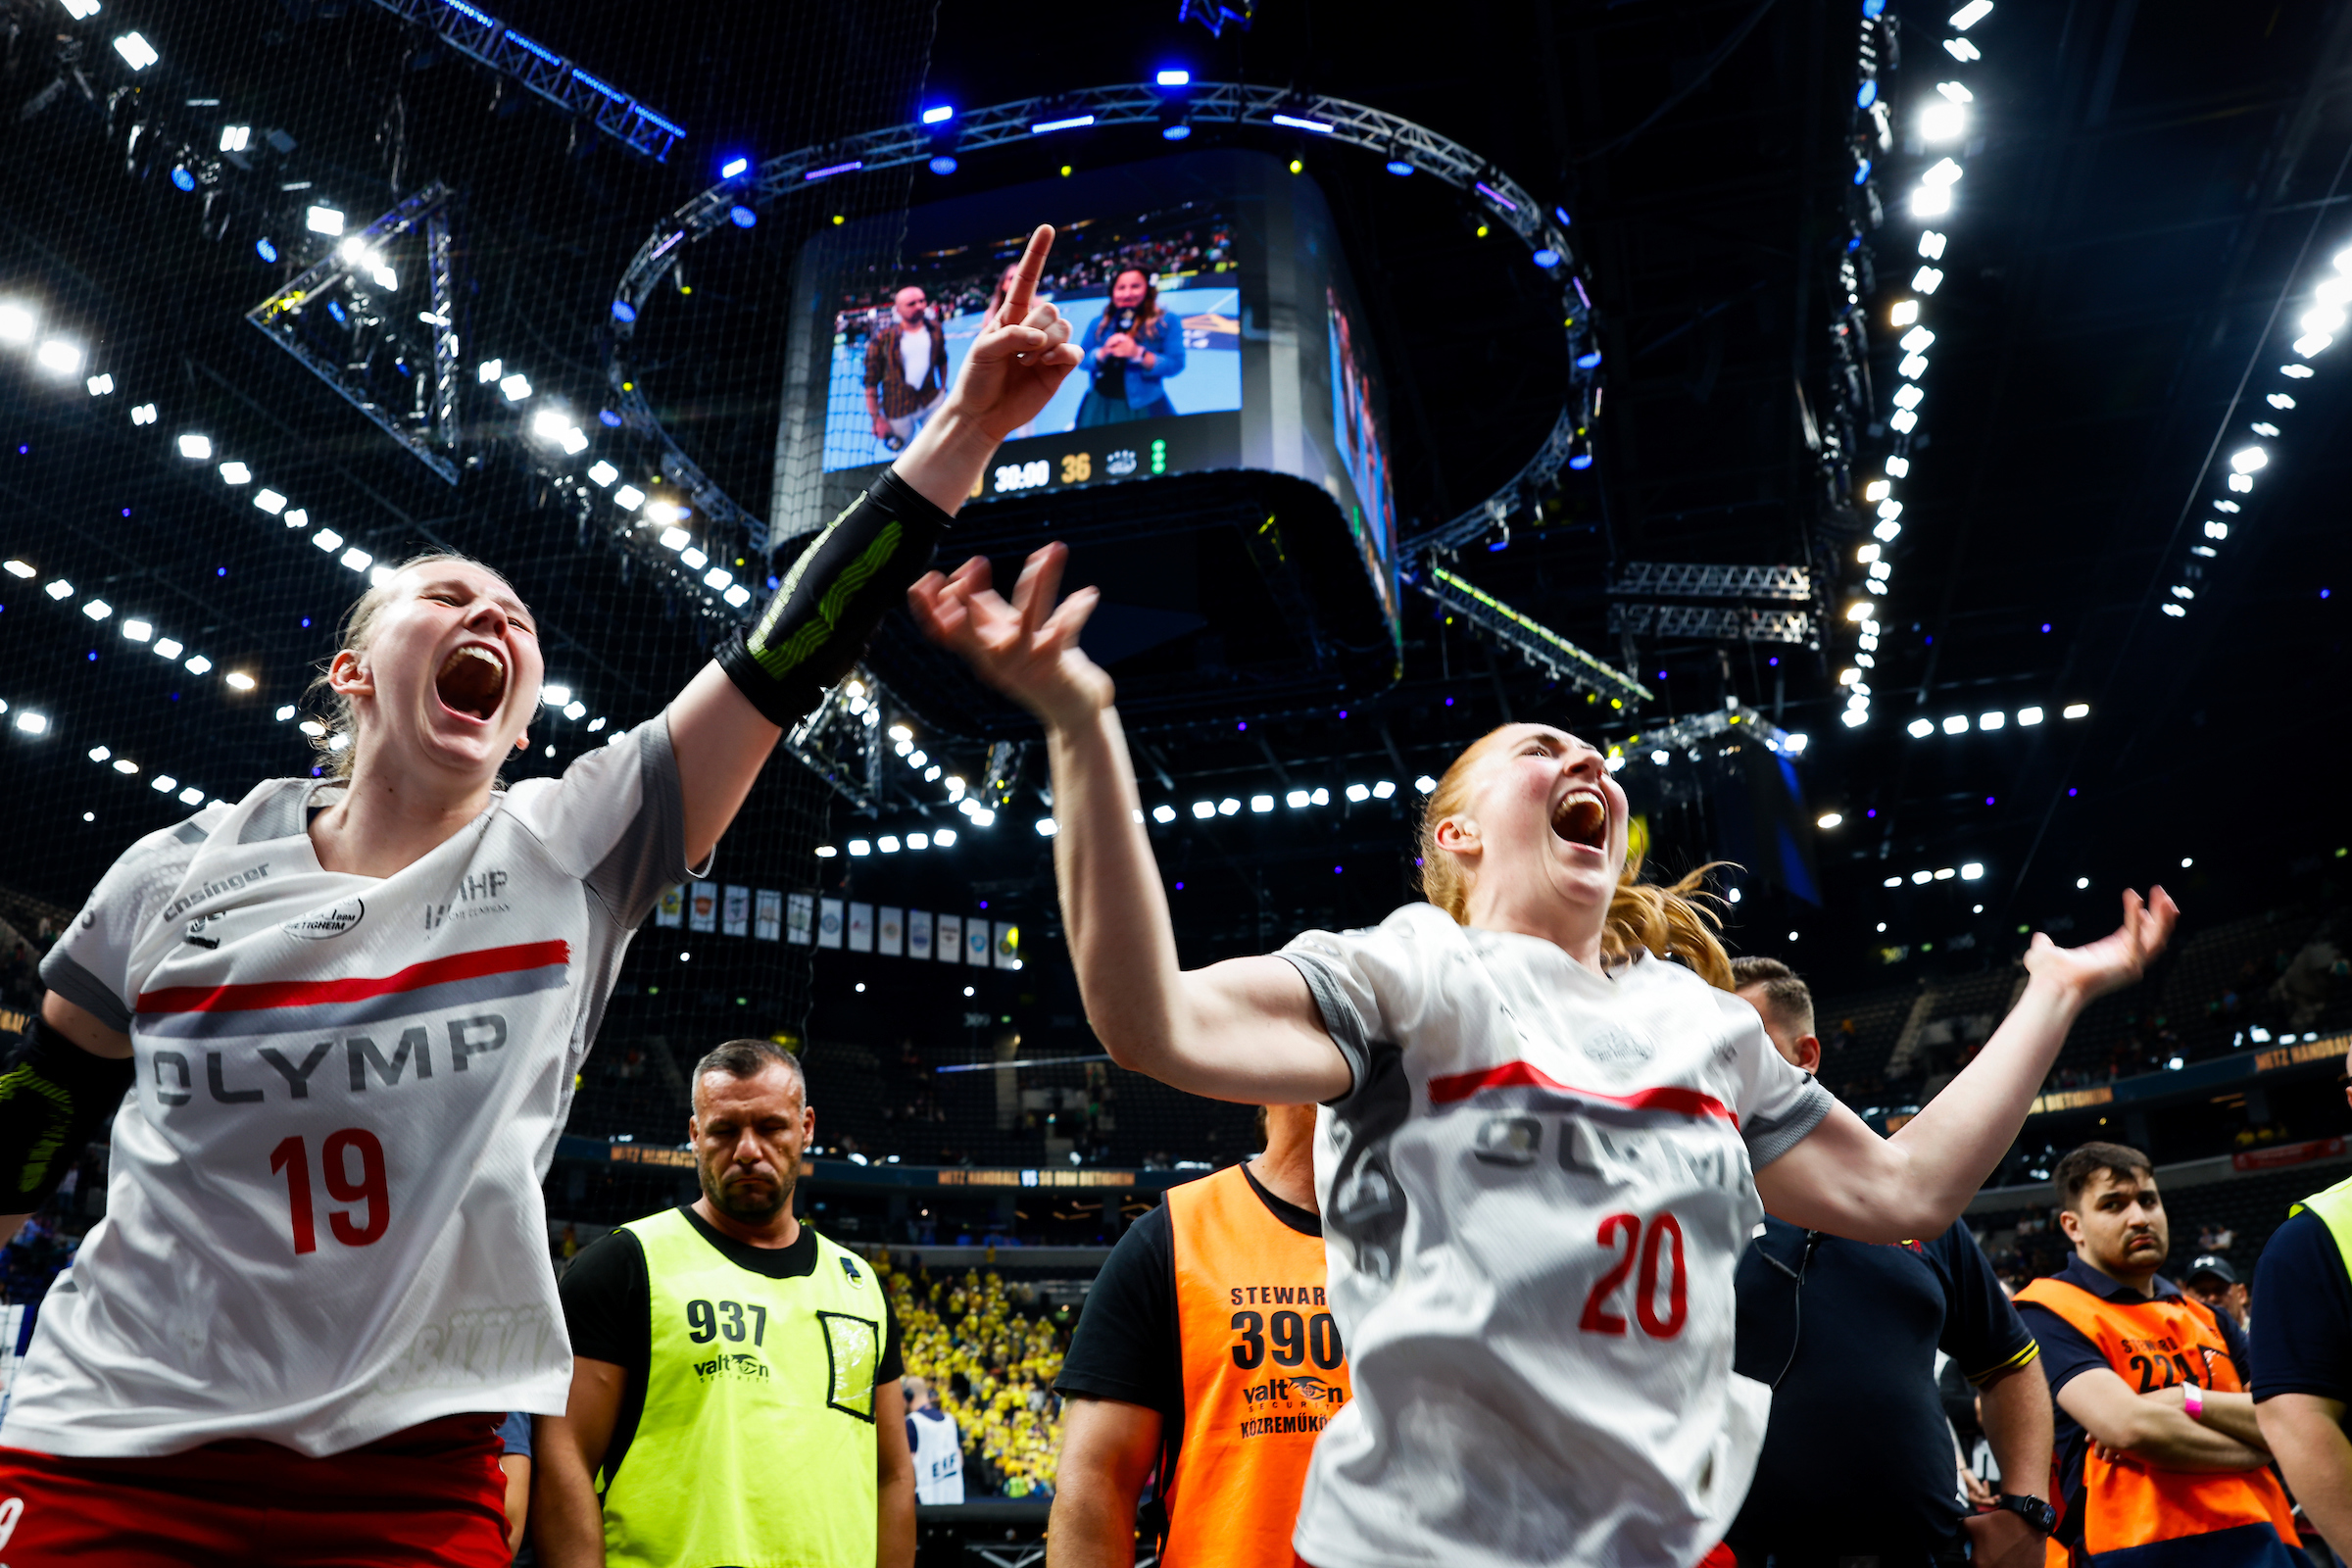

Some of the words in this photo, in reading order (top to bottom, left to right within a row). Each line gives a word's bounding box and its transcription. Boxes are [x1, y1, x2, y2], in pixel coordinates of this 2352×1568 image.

[994, 460, 1051, 493] 30:00
[1060, 453, 1092, 484] 36
[164, 863, 270, 922] ensinger
[153, 1013, 509, 1107] OLYMP
[269, 1127, 391, 1255] 19
[1231, 1287, 1326, 1305] STEWAR
[1578, 1210, 1688, 1342] 20
[687, 1299, 766, 1348] 937
[1231, 1310, 1344, 1370] 390
[1241, 1412, 1328, 1440] KÖZREMŰKÖ
